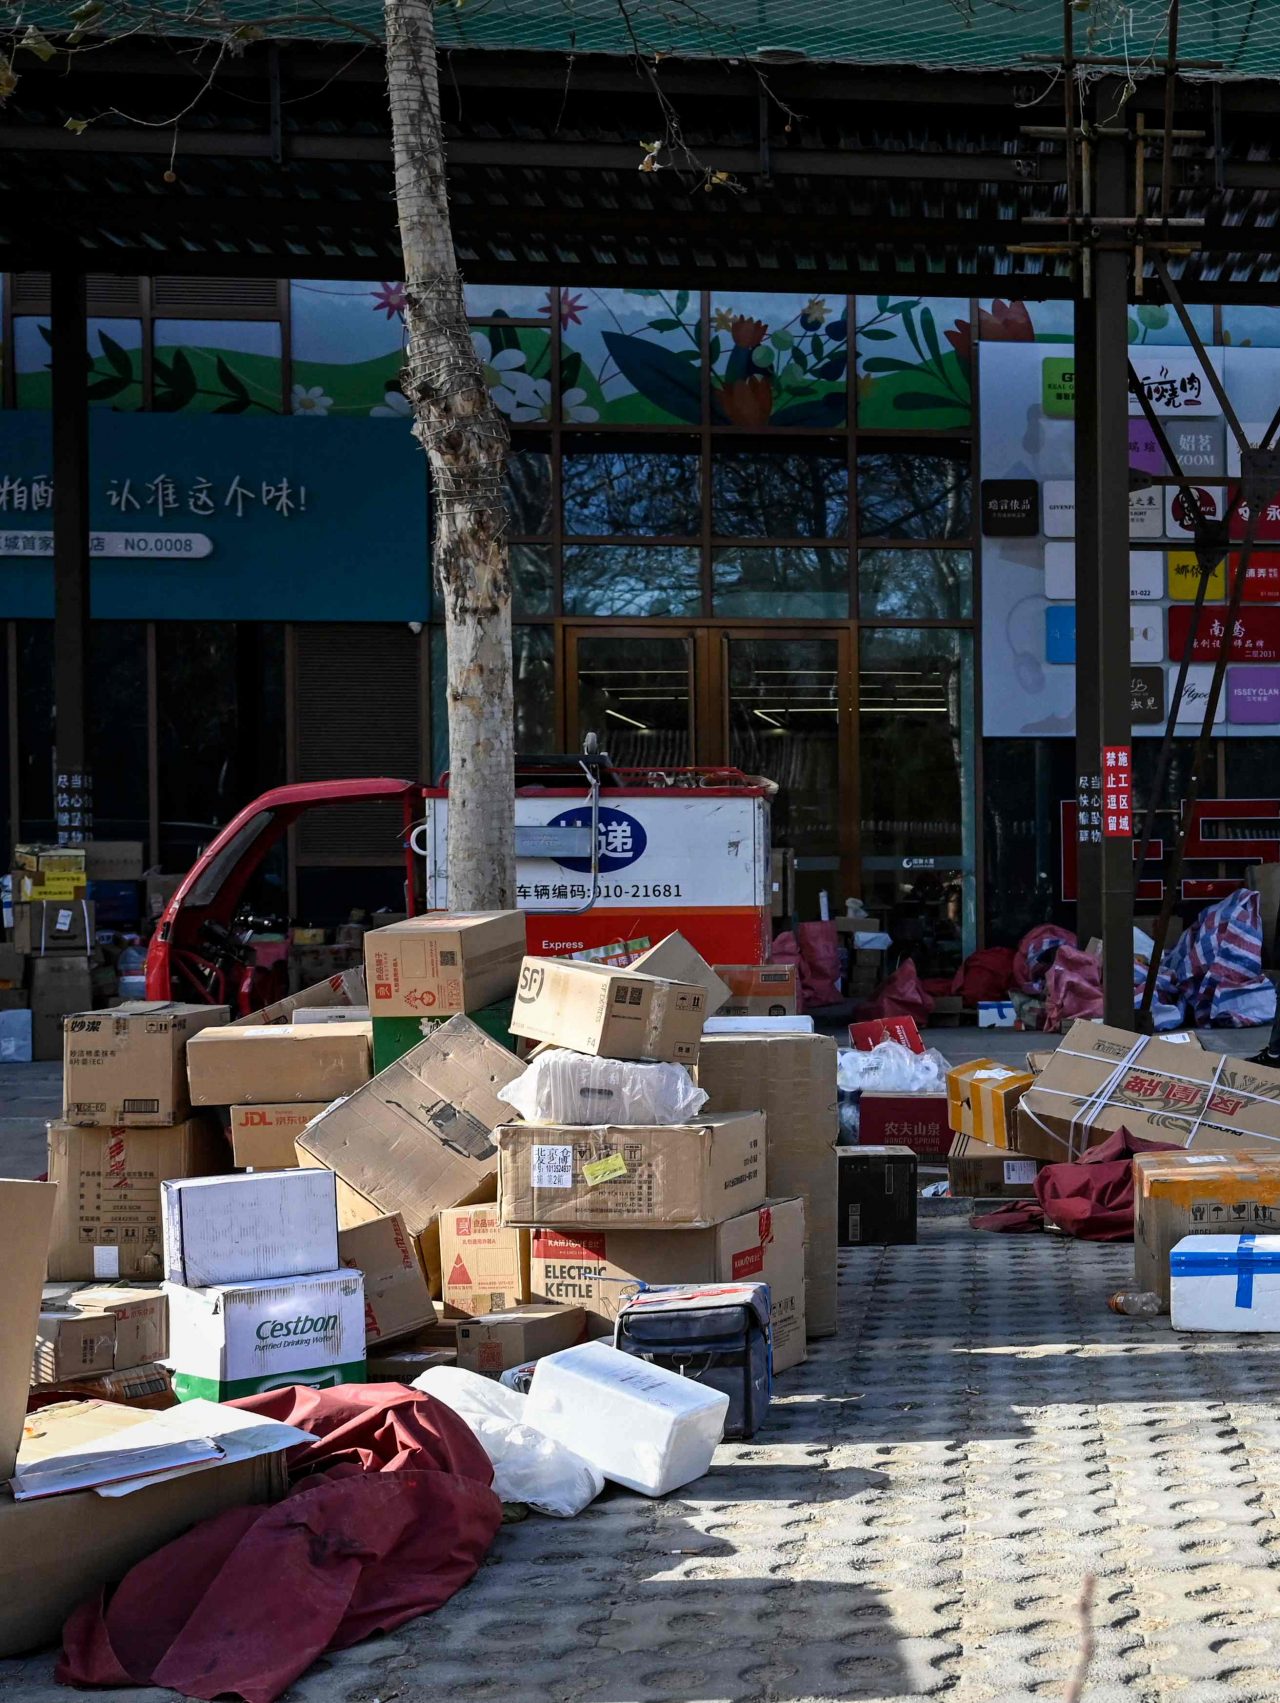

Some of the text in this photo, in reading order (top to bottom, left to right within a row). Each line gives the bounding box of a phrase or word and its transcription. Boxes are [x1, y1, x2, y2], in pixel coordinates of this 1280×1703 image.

[1175, 454, 1215, 466] ZOOM
[104, 473, 308, 518] 认准这个味!
[124, 537, 193, 553] NO.0008
[1192, 638, 1264, 649] 原创设师品牌
[1105, 750, 1118, 832] 禁止逗留
[1117, 751, 1130, 832] 施工区域
[541, 939, 585, 952] Express
[239, 1111, 273, 1127] JDL
[883, 1120, 941, 1137] 农夫山泉
[544, 1264, 607, 1281] ELECTRIC
[544, 1282, 593, 1299] KETTLE
[255, 1313, 339, 1341] C'estbon
[254, 1340, 282, 1352] Purified
[282, 1337, 312, 1349] Drinking
